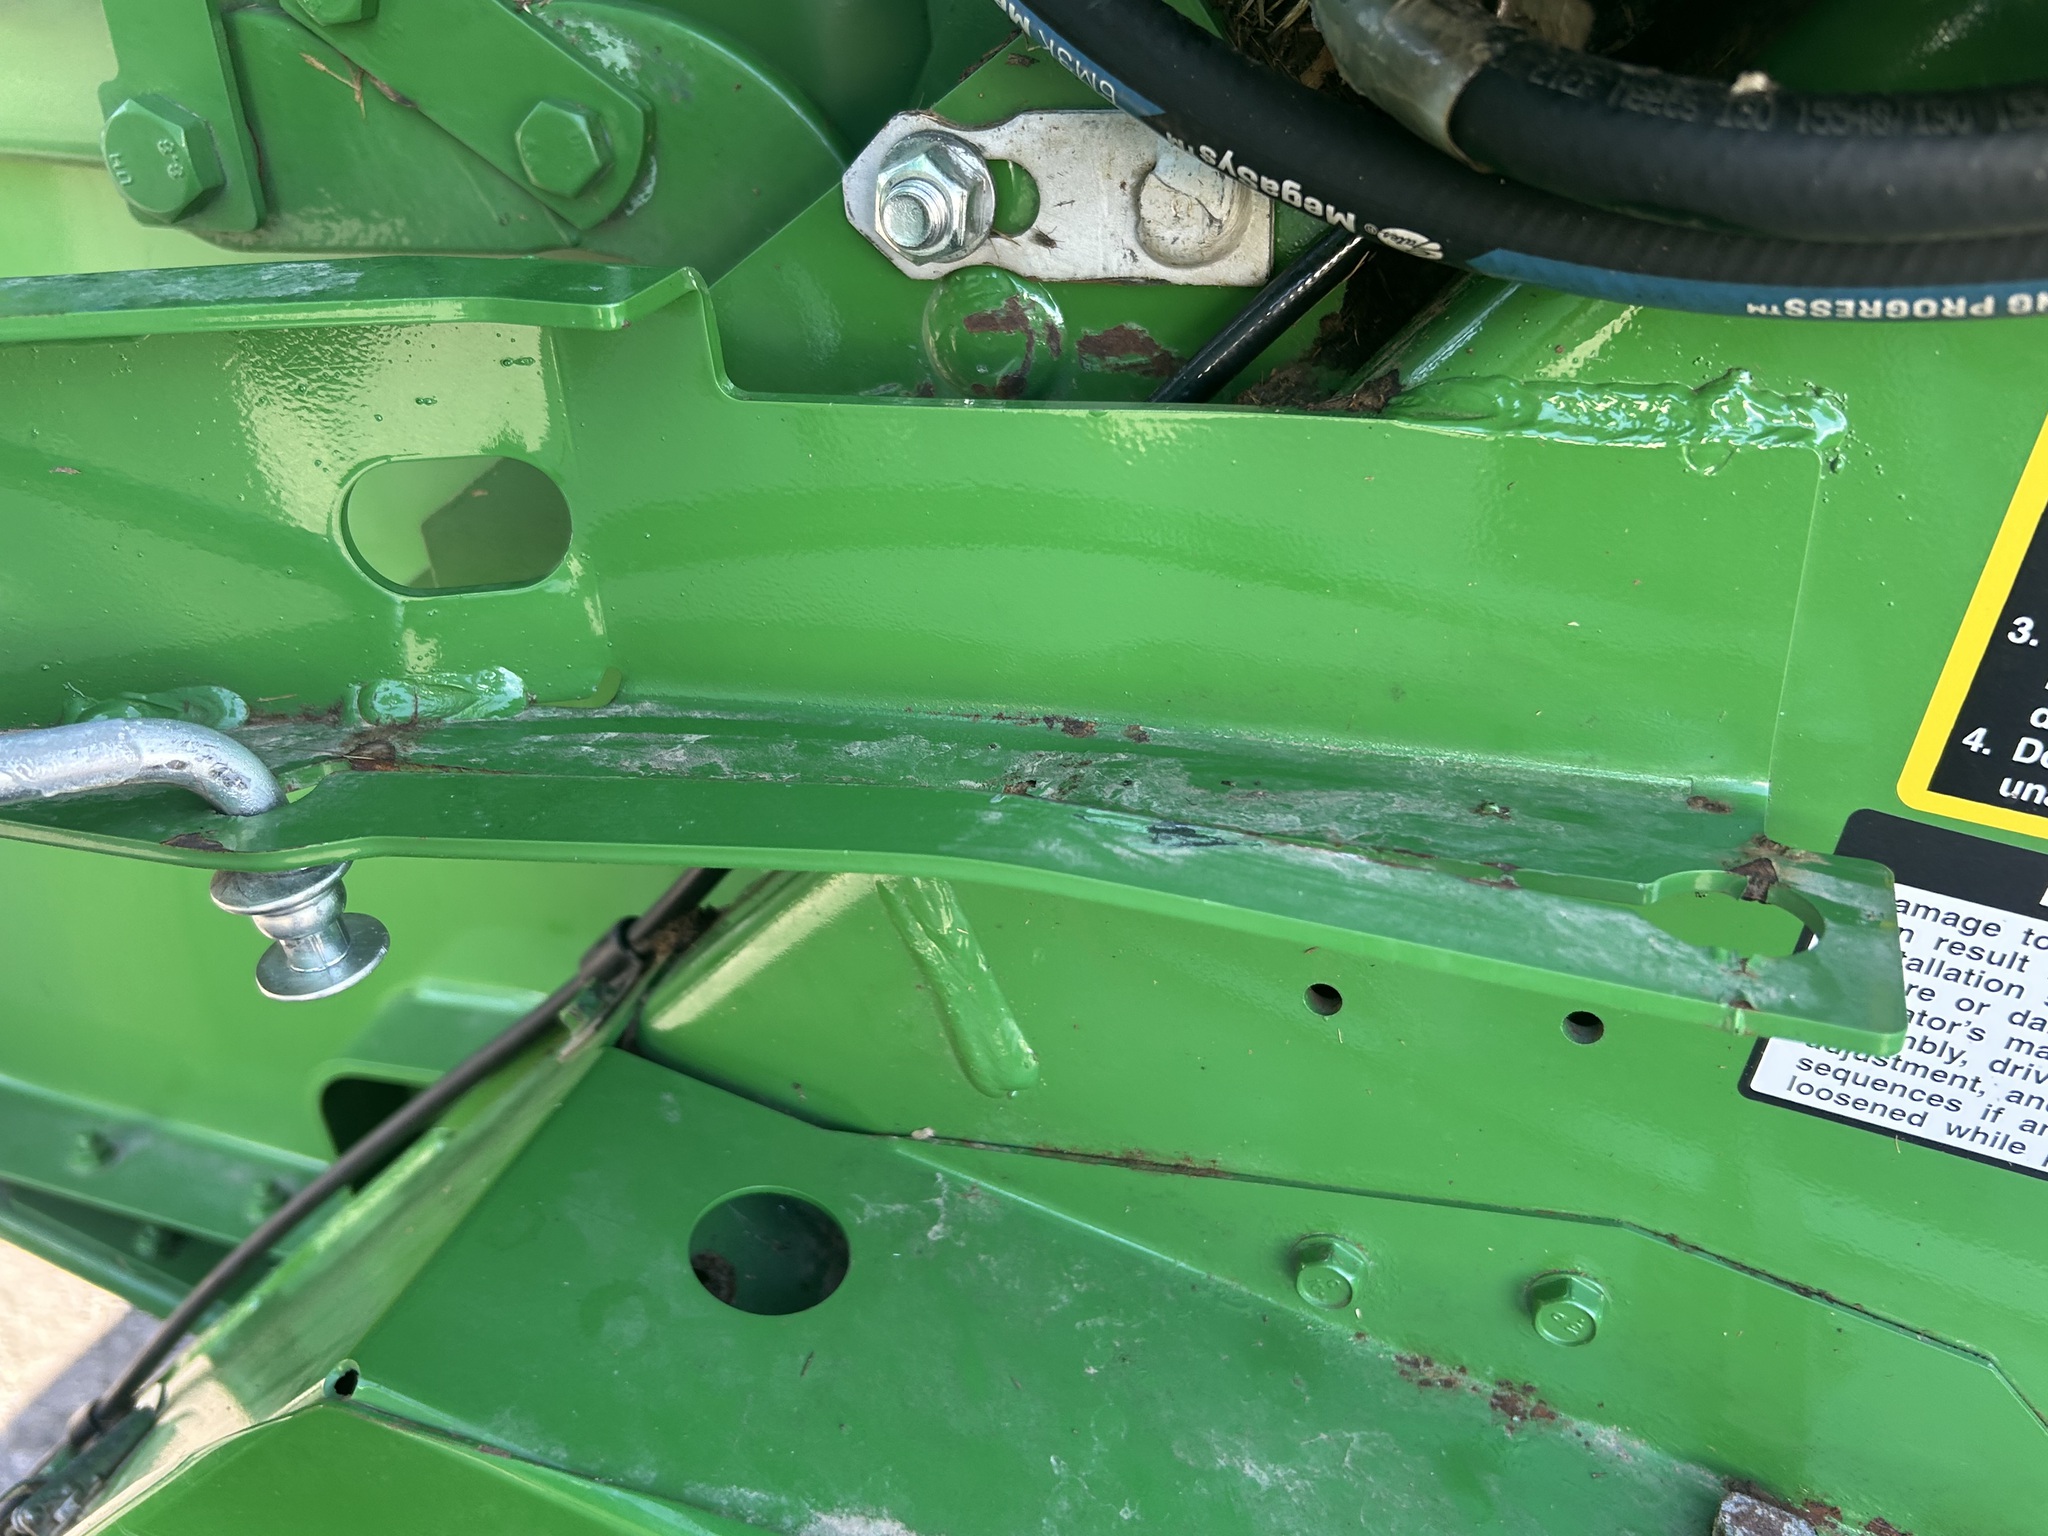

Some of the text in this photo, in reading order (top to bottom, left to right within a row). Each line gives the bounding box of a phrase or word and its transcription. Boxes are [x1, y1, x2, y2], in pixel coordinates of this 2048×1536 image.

[2007, 616, 2040, 647] 3.
[1962, 727, 1992, 756] 4.
[1933, 936, 2031, 973] result
[1955, 997, 1991, 1016] or
[1795, 1057, 1963, 1113] sequences
[1980, 1103, 2006, 1124] if
[1786, 1075, 2027, 1155] loosened while
